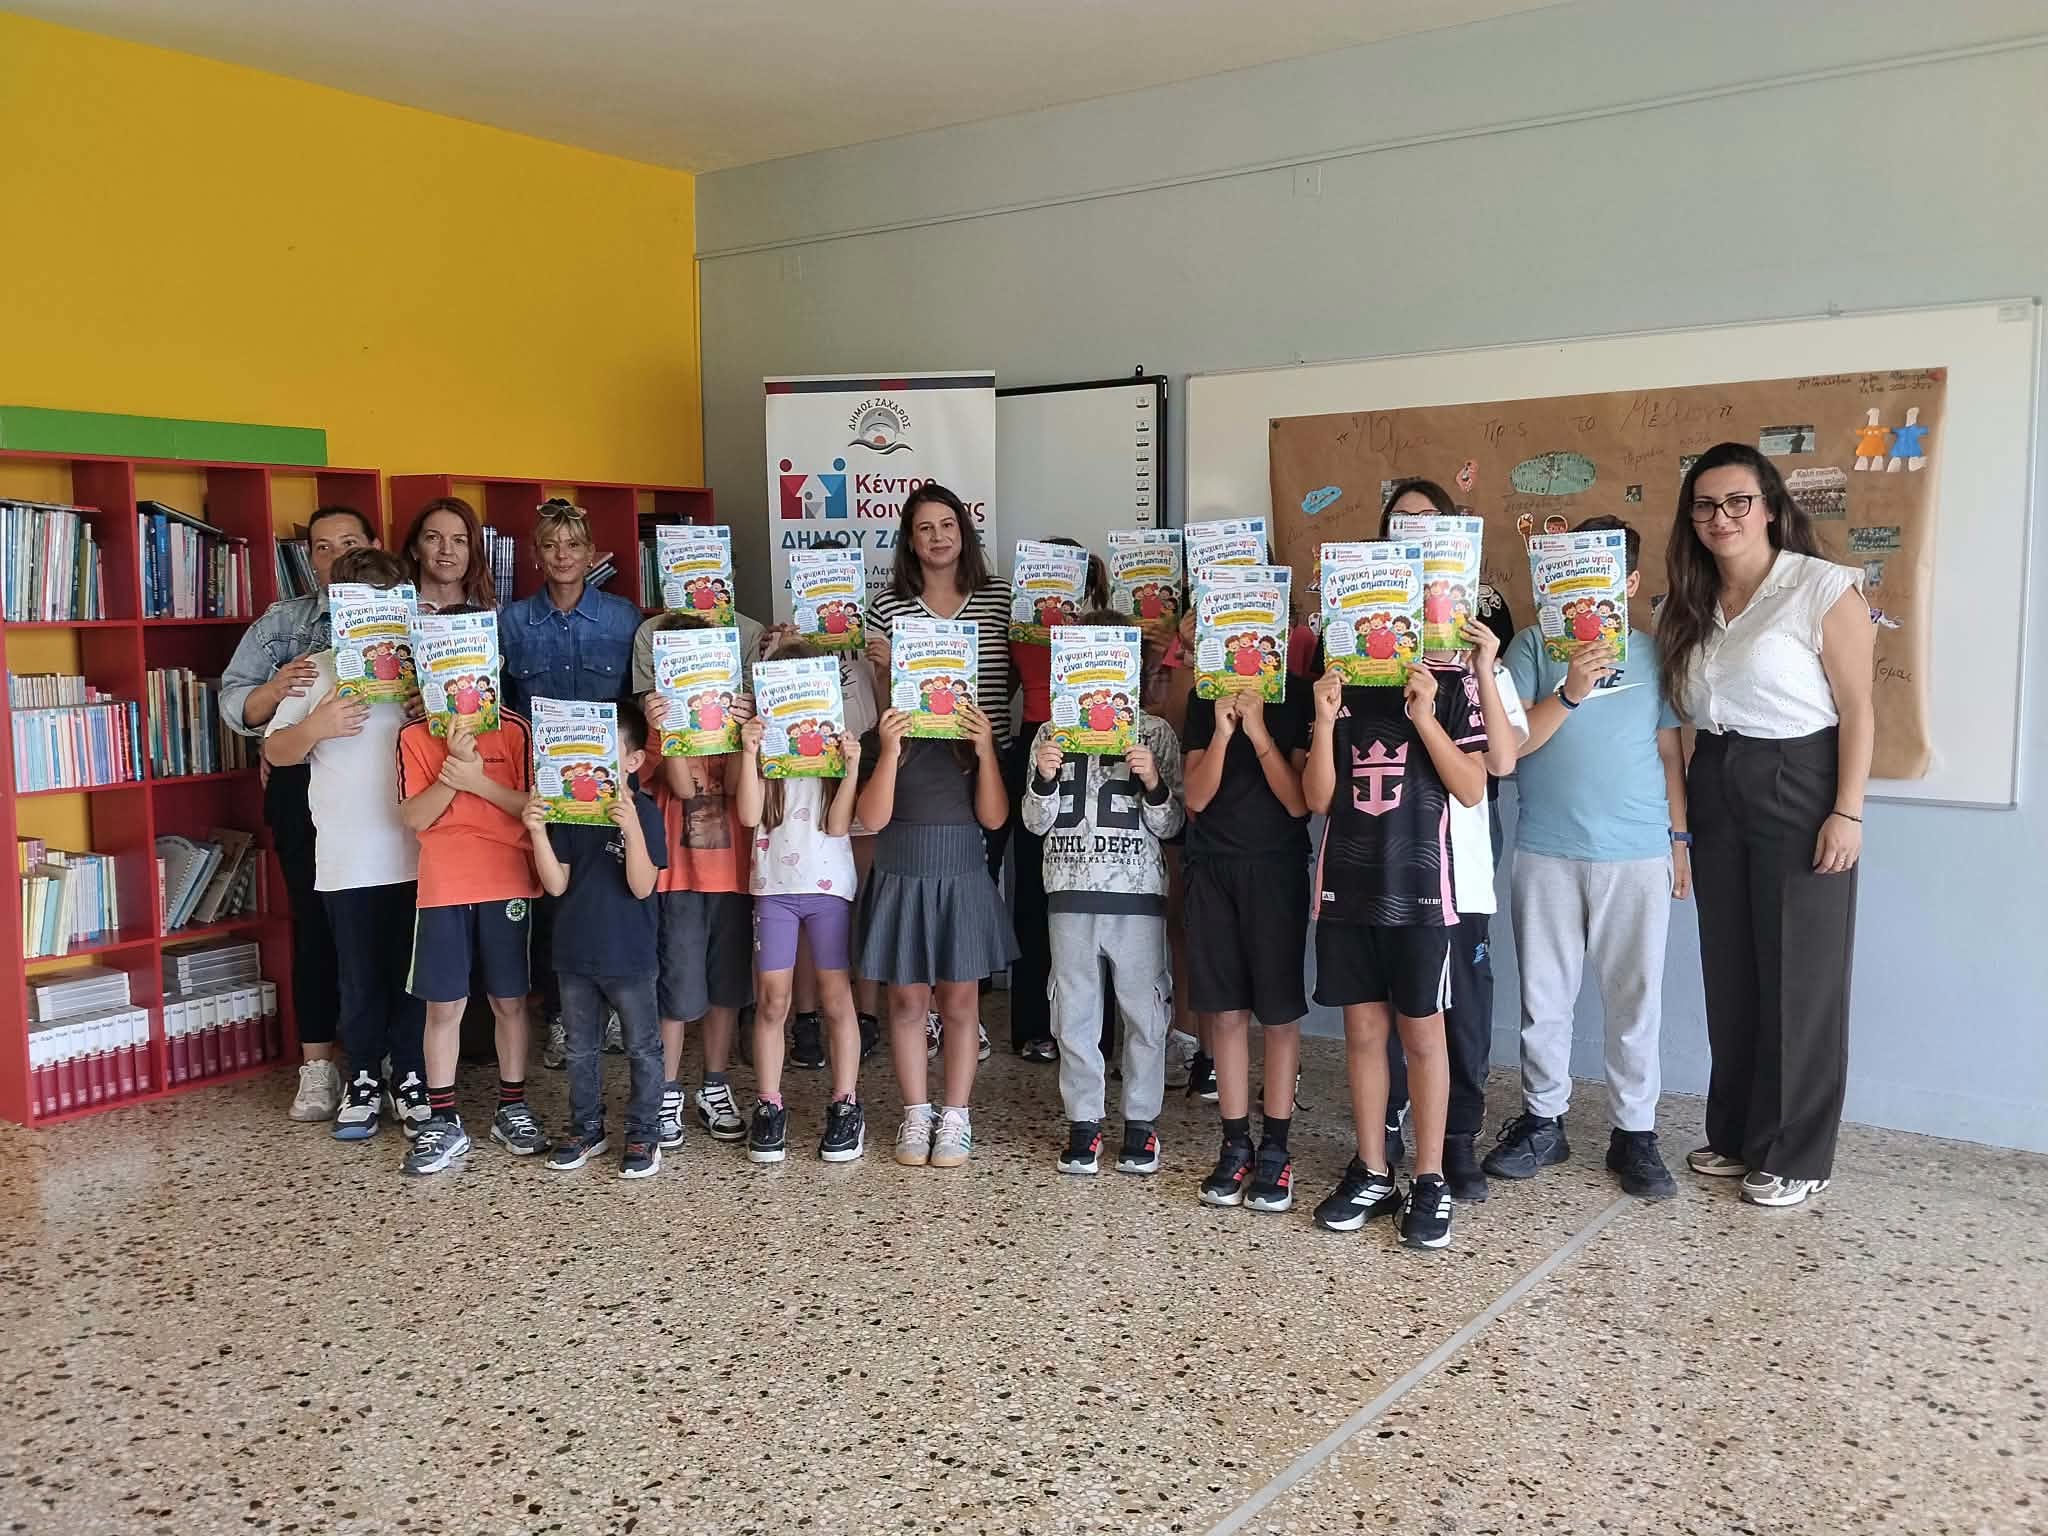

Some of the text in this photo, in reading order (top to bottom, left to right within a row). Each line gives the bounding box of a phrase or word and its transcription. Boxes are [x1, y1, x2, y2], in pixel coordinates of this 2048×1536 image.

[848, 398, 912, 431] ΔΗΜΟΣ ΖΑΧΑΡΩΣ
[855, 474, 937, 494] Κέντρο
[857, 499, 985, 522] Κοινας
[781, 530, 867, 549] ΔΗΜΟΥ
[1546, 557, 1573, 570] ψυχική
[1339, 568, 1370, 583] ψυχική
[1361, 577, 1408, 590] σημαντική!
[1065, 649, 1093, 660] ψυχική
[1094, 835, 1144, 855] DEPT
